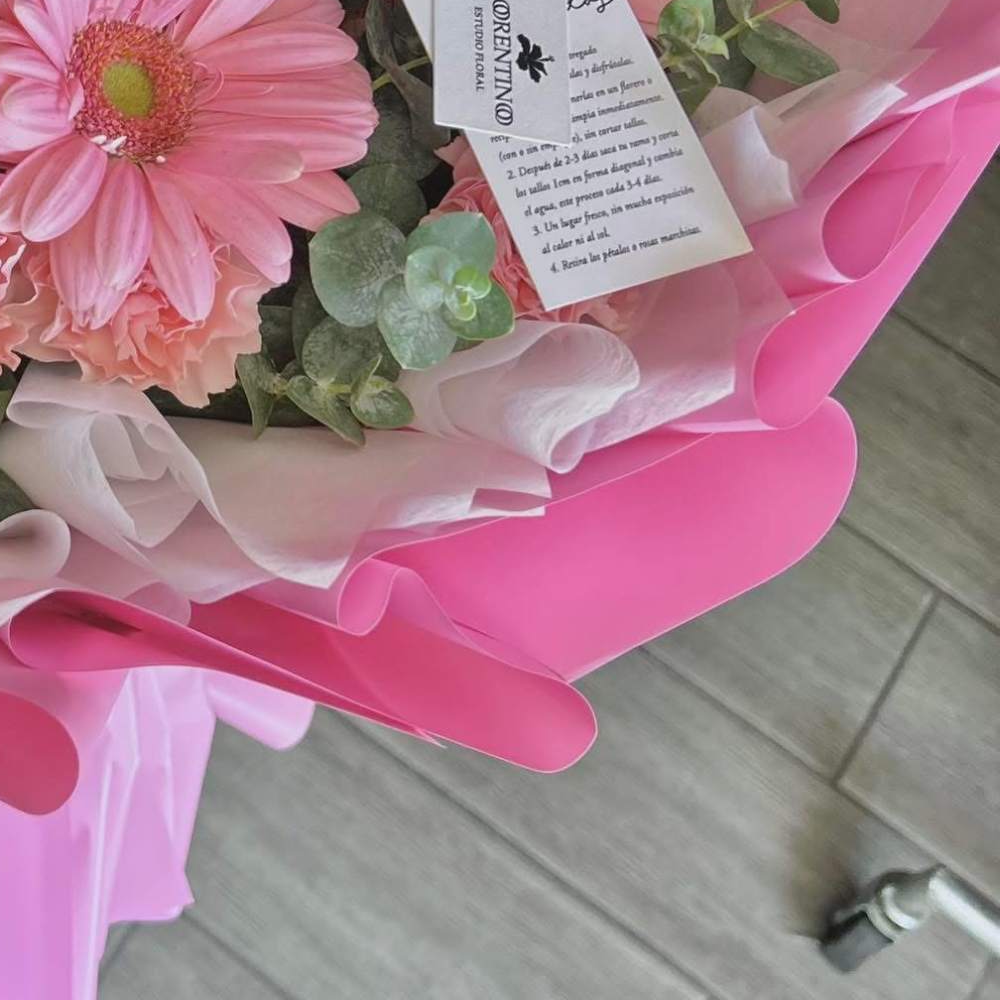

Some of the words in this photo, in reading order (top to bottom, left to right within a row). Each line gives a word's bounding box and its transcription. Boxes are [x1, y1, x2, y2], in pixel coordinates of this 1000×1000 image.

[473, 6, 484, 51] ESTUDIO
[474, 52, 485, 93] FLORAL
[570, 90, 594, 103] nerlas
[595, 90, 606, 98] en
[607, 86, 619, 94] un
[571, 110, 596, 123] impia
[498, 151, 518, 163] (con
[526, 145, 539, 154] sin
[583, 130, 597, 140] sin
[598, 124, 622, 136] cortar
[506, 170, 516, 180] 2.
[518, 161, 551, 177] Después
[553, 157, 563, 168] de
[564, 152, 580, 165] 2-3
[581, 151, 598, 161] días
[651, 136, 657, 146] y
[515, 187, 527, 198] los
[528, 181, 551, 194] tallos
[572, 175, 582, 183] en
[583, 168, 609, 184] forma
[610, 155, 646, 174] diagonal
[646, 157, 652, 167] y
[653, 147, 684, 162] cambia
[524, 205, 532, 217] el
[559, 198, 574, 208] este
[575, 190, 604, 207] proceso
[605, 182, 625, 195] cada
[626, 177, 642, 190] 3-4
[532, 225, 543, 236] 3.
[544, 221, 559, 232] Un
[560, 217, 582, 229] lugar
[583, 210, 609, 225] fresco,
[611, 203, 623, 214] sin
[625, 196, 652, 210] mucha
[654, 185, 695, 205] exposición
[541, 242, 551, 254] al
[552, 238, 573, 252] calor
[575, 235, 585, 245] ni
[586, 230, 596, 242] al
[596, 226, 611, 240] sol.
[550, 261, 560, 273] 4.
[588, 252, 601, 263] los
[602, 244, 630, 263] pétalos
[631, 243, 637, 251] o
